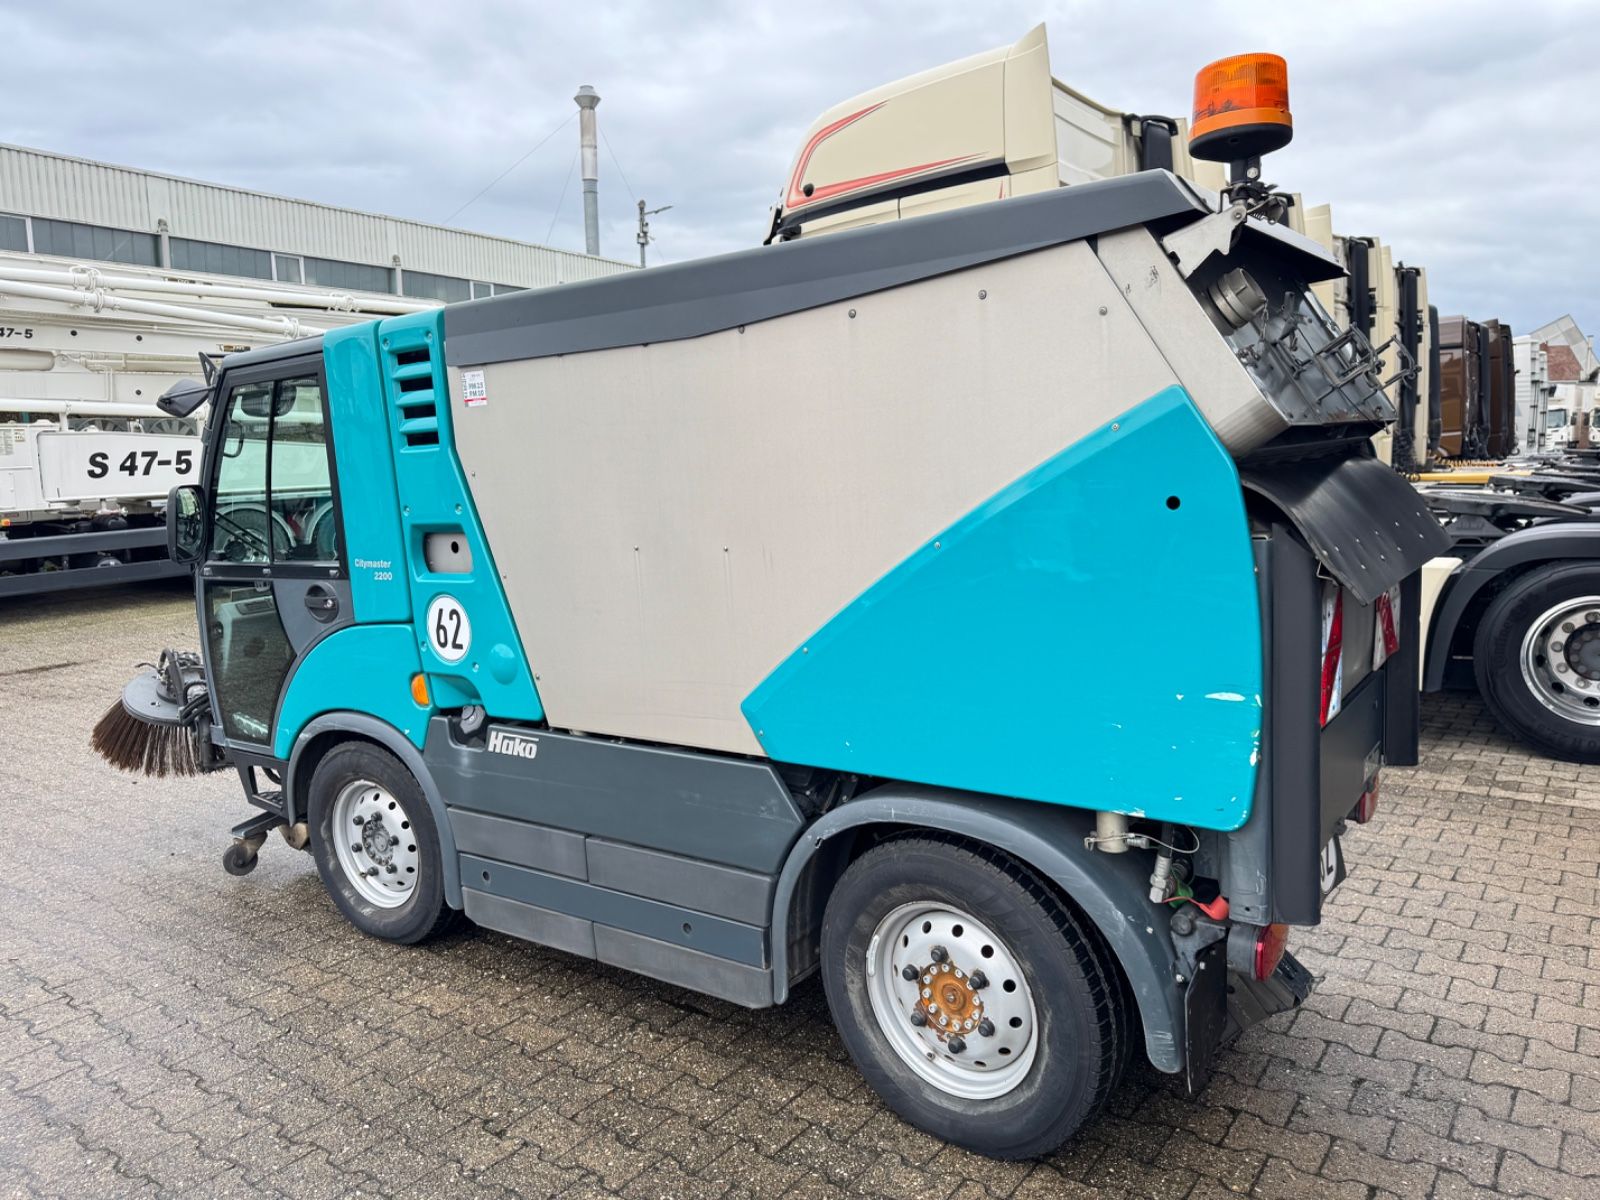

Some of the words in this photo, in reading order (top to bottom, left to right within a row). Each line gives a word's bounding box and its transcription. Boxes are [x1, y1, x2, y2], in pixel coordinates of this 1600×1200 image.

[87, 452, 109, 479] S
[119, 450, 192, 476] 47-5
[354, 558, 391, 569] Citymaster
[374, 571, 392, 581] 2200
[436, 608, 463, 650] 62
[488, 730, 539, 759] Hako
